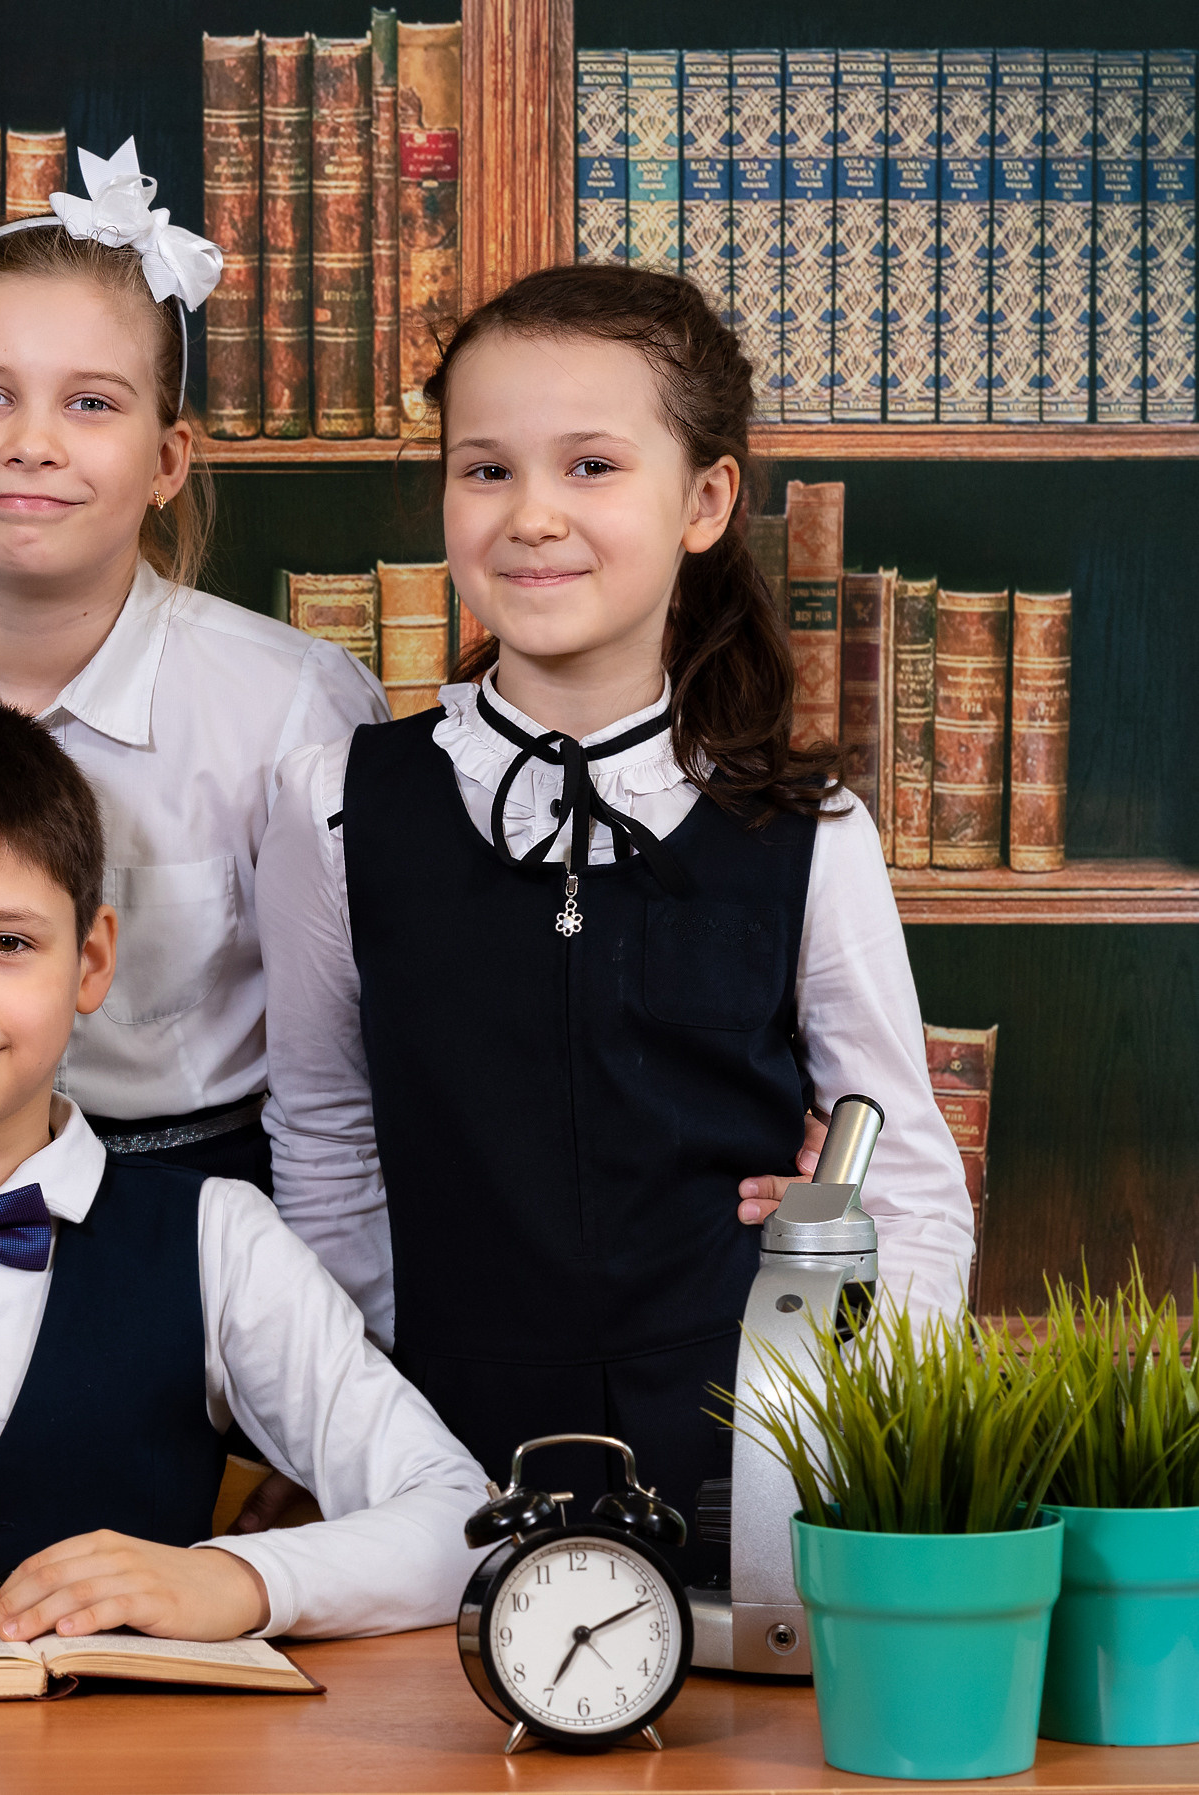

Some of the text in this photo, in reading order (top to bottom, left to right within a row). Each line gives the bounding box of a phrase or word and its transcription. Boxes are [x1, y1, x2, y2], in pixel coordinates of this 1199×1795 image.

[794, 610, 832, 622] BEN HUR
[567, 1551, 587, 1572] 12
[609, 1560, 617, 1580] 1
[535, 1565, 552, 1585] 11
[511, 1592, 529, 1612] 10
[635, 1584, 651, 1604] 2
[499, 1627, 513, 1647] 9
[649, 1622, 661, 1642] 3
[513, 1663, 526, 1683] 8
[637, 1658, 651, 1677] 4
[543, 1688, 555, 1708] 7
[615, 1686, 627, 1706] 5
[577, 1697, 590, 1718] 6
